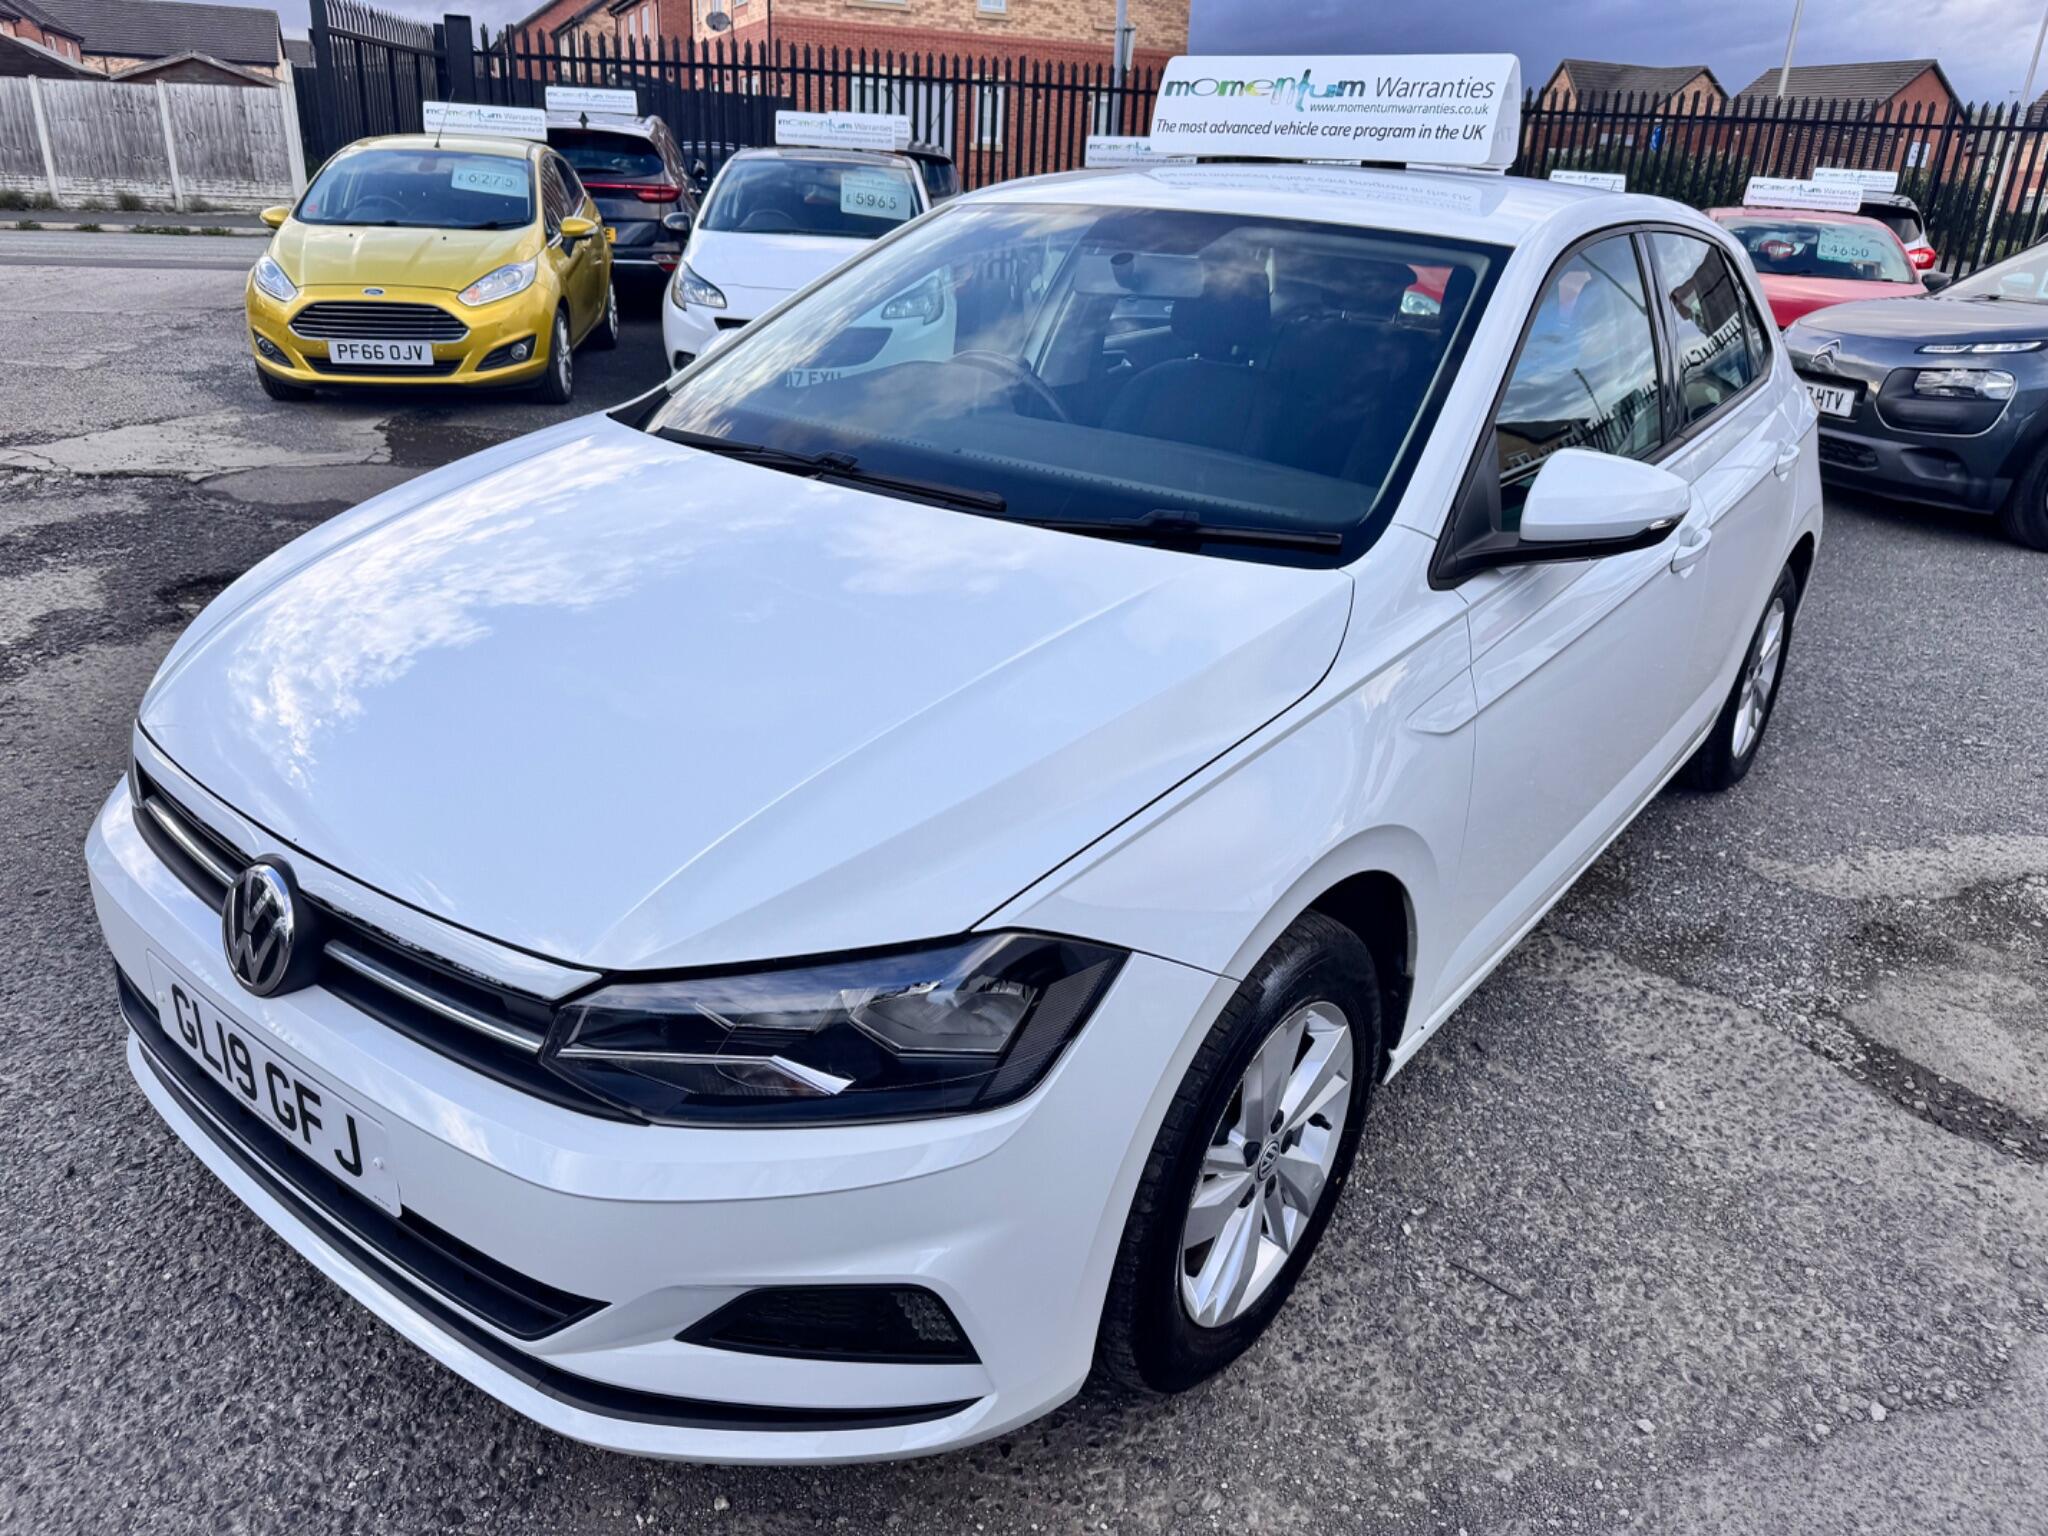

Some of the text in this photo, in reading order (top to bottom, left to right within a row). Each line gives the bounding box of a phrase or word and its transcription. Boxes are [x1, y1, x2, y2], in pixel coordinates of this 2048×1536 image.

[1164, 68, 1496, 112] momentum Warranties
[1310, 102, 1489, 115] www.momentumwarranties.co.uk
[1156, 118, 1177, 133] The
[1178, 121, 1207, 134] most
[1209, 120, 1272, 135] advanced
[1274, 121, 1319, 136] vehicle
[1321, 125, 1351, 137] care
[1353, 125, 1416, 141] program
[1418, 123, 1431, 139] in
[1434, 124, 1459, 140] the
[1462, 124, 1487, 140] UK
[336, 343, 385, 360] PF66
[171, 983, 258, 1101] GL19
[265, 1060, 363, 1178] GFJ
